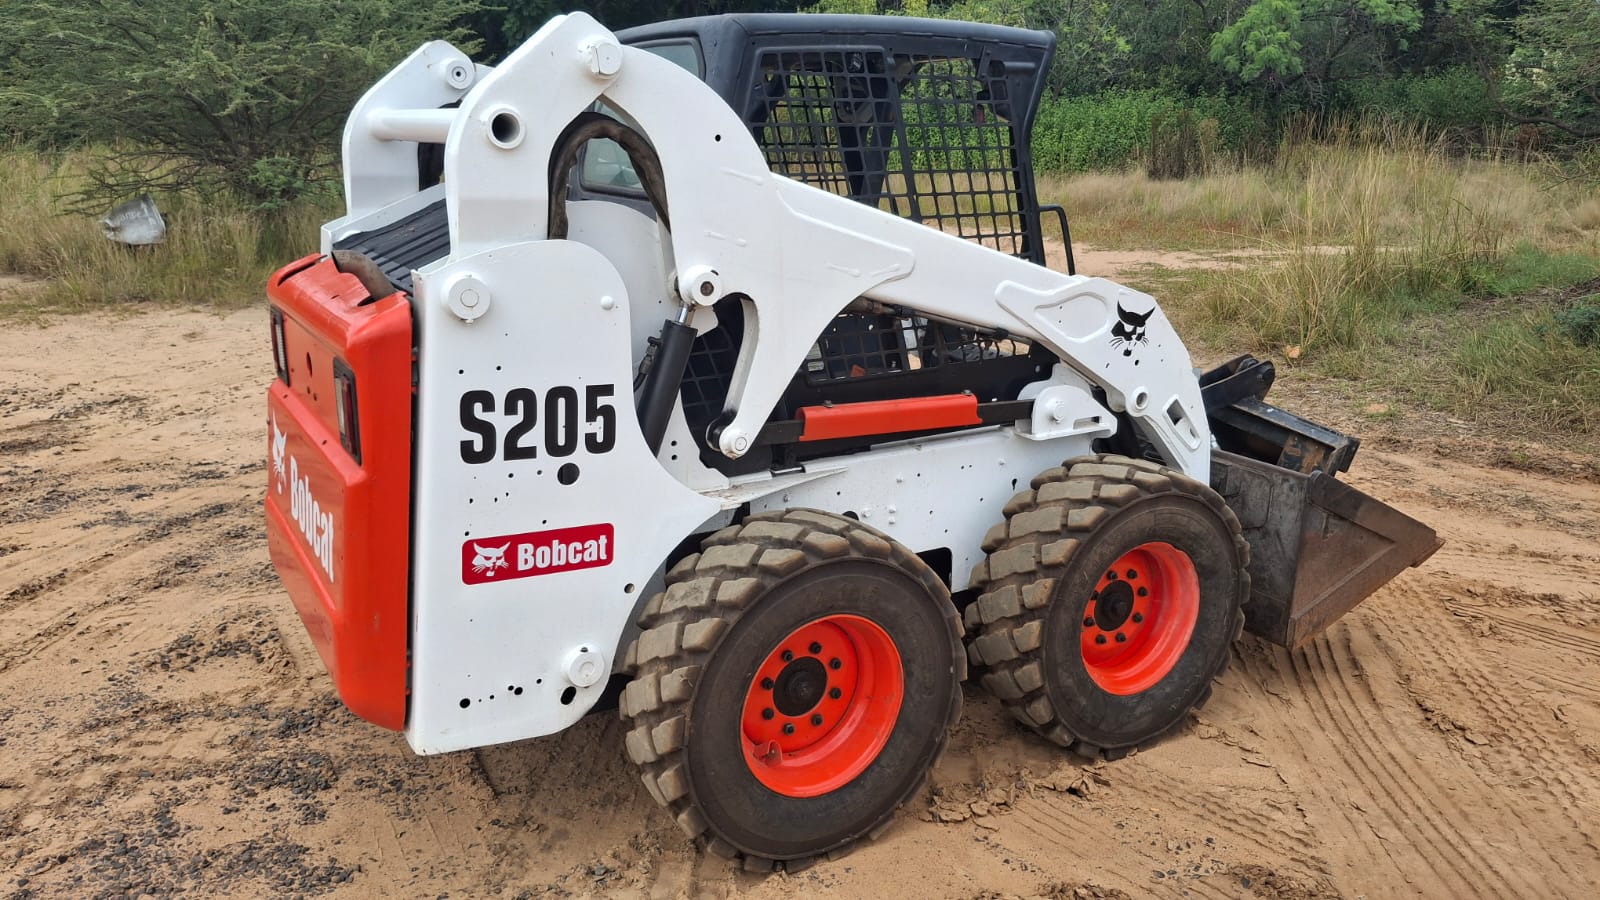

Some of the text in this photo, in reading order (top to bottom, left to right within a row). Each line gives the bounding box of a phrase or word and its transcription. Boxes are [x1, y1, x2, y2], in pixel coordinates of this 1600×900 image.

[459, 383, 616, 464] S205
[290, 455, 335, 584] Bobcat
[517, 534, 608, 571] Bobcat
